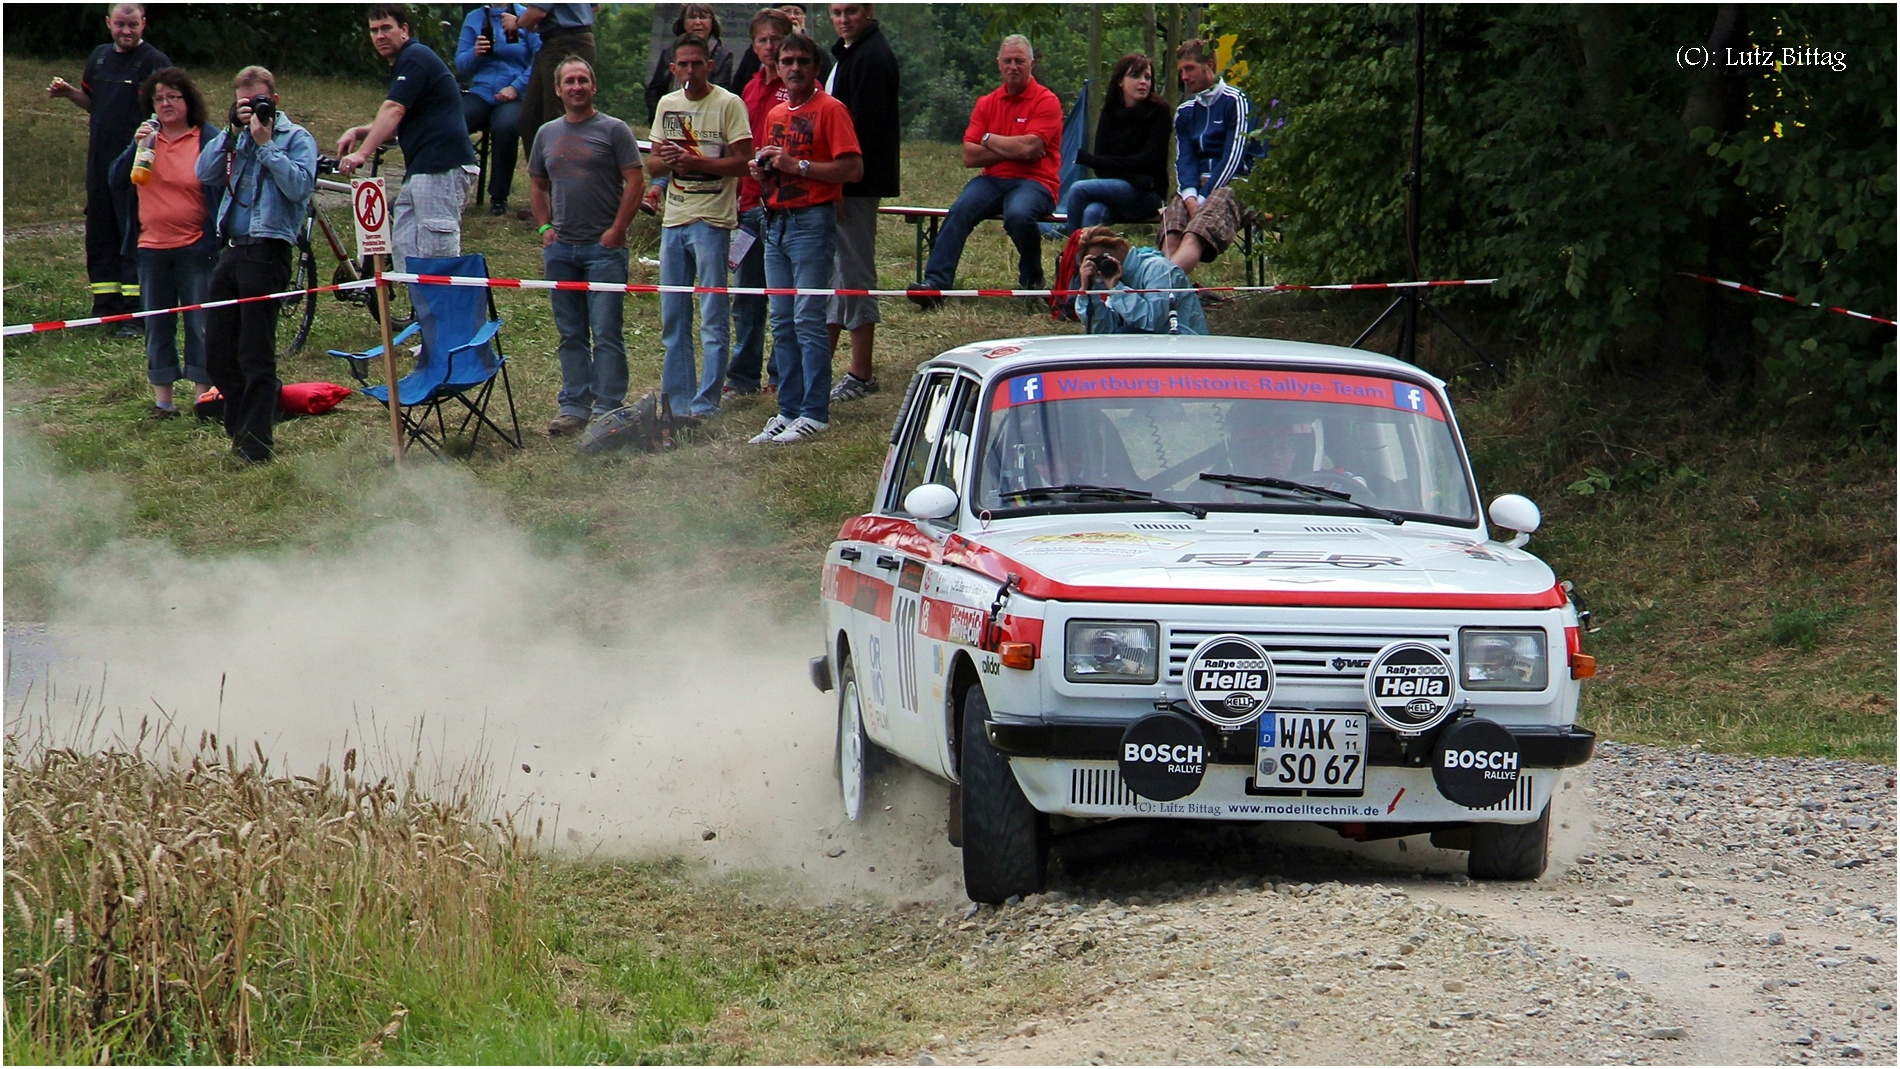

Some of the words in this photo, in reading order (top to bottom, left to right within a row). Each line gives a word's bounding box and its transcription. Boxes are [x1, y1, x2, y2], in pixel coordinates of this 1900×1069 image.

[895, 595, 918, 714] 110
[1204, 659, 1236, 670] Rallye
[1236, 660, 1265, 669] 3000
[1385, 666, 1417, 676] Rallye
[1417, 666, 1446, 675] 3000
[1200, 672, 1262, 689] Hella
[1381, 678, 1443, 695] Hella
[1345, 719, 1359, 728] 04
[1263, 734, 1271, 743] D
[1280, 718, 1335, 749] WAK
[1345, 741, 1357, 750] 11
[1124, 743, 1203, 763] BOSCH
[1444, 749, 1518, 770] BOSCH
[1168, 765, 1202, 774] RALLYE
[1279, 754, 1316, 784] SO
[1324, 754, 1360, 785] 67
[1484, 770, 1516, 780] RALLYE
[1228, 804, 1380, 816] www.modelltechnik.de
